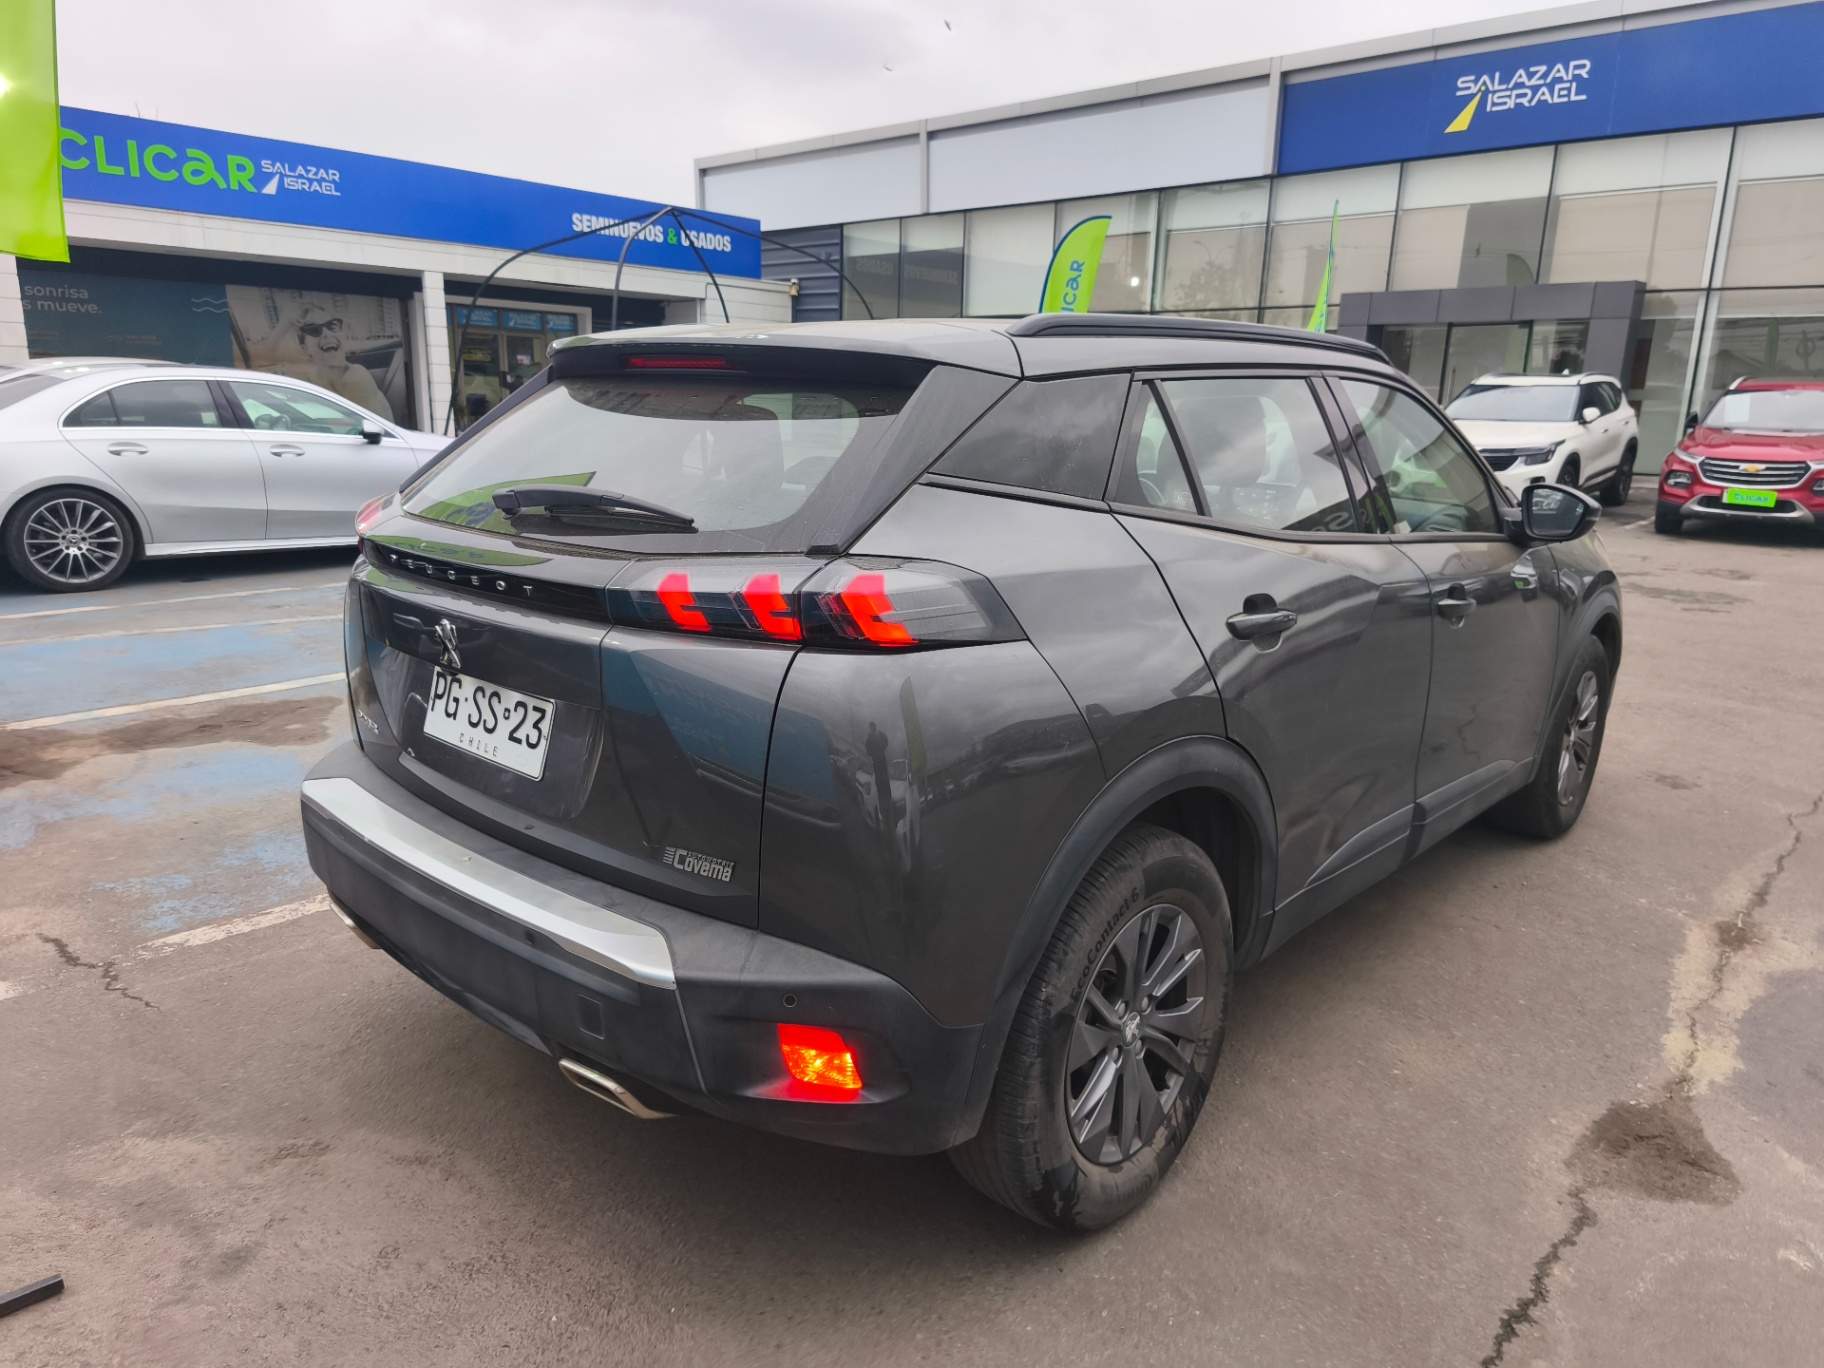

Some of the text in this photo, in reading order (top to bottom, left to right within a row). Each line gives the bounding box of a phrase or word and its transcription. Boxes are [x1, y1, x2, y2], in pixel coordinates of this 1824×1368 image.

[1456, 59, 1591, 96] SALAZAR
[1486, 81, 1588, 112] ISRAEL
[261, 159, 340, 182] SALAZAR
[283, 178, 341, 196] ISRAEL
[572, 212, 732, 252] SEMINUEVOS & USADOS
[23, 284, 89, 299] sonrisa
[37, 299, 102, 314] mueve.
[389, 553, 533, 597] PEUGEOT
[459, 732, 499, 758] CHILE
[673, 848, 732, 882] Covema
